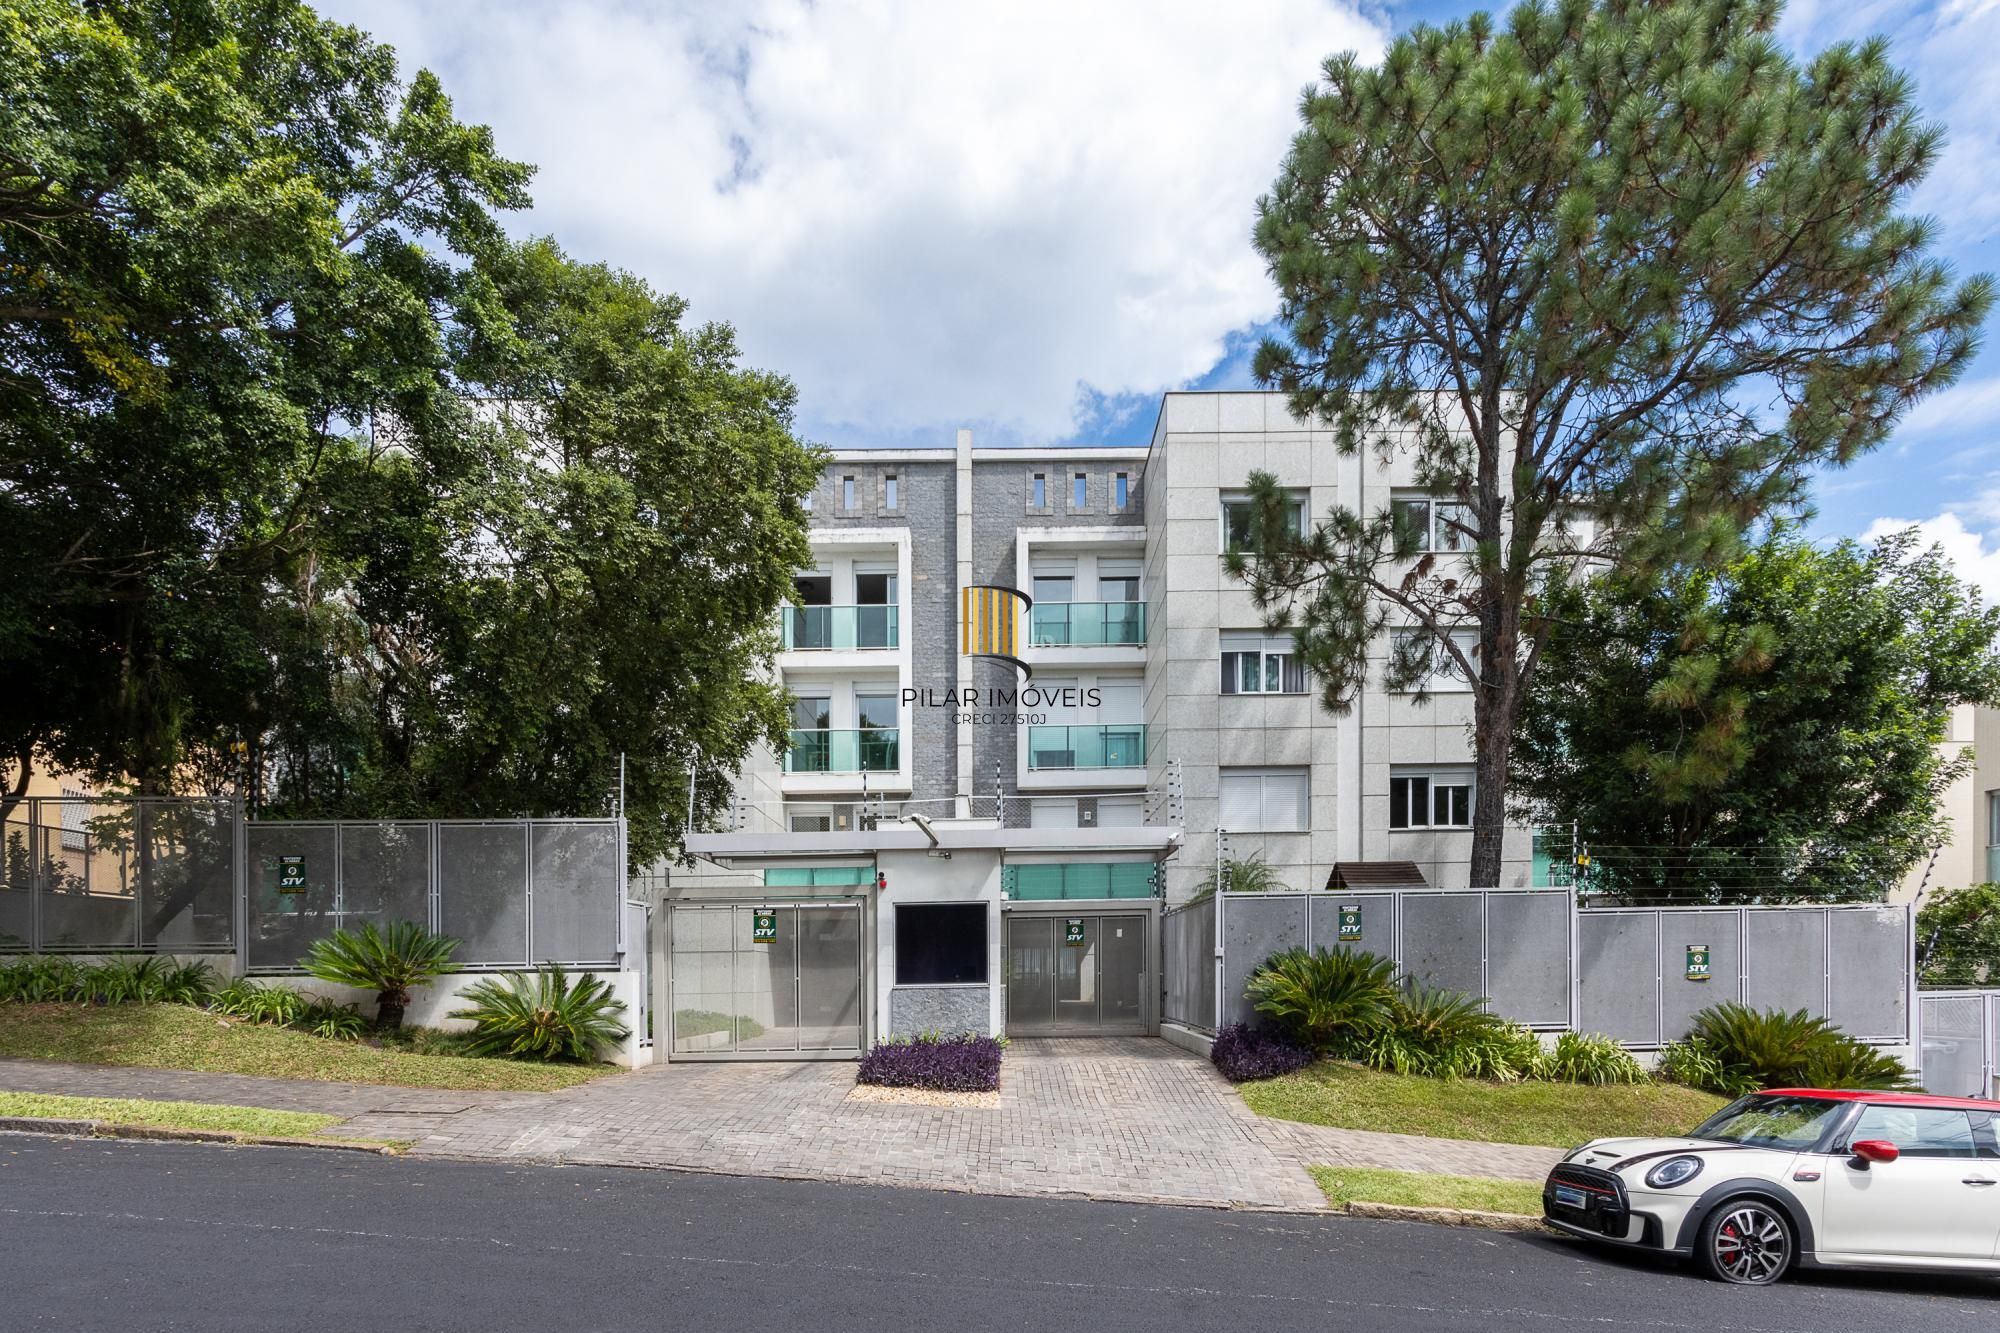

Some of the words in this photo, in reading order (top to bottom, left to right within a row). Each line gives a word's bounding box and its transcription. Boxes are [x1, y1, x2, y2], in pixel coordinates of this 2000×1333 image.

[281, 877, 305, 886] STV
[754, 928, 775, 936] STV
[1340, 925, 1361, 933] STV
[1688, 964, 1708, 972] STV
